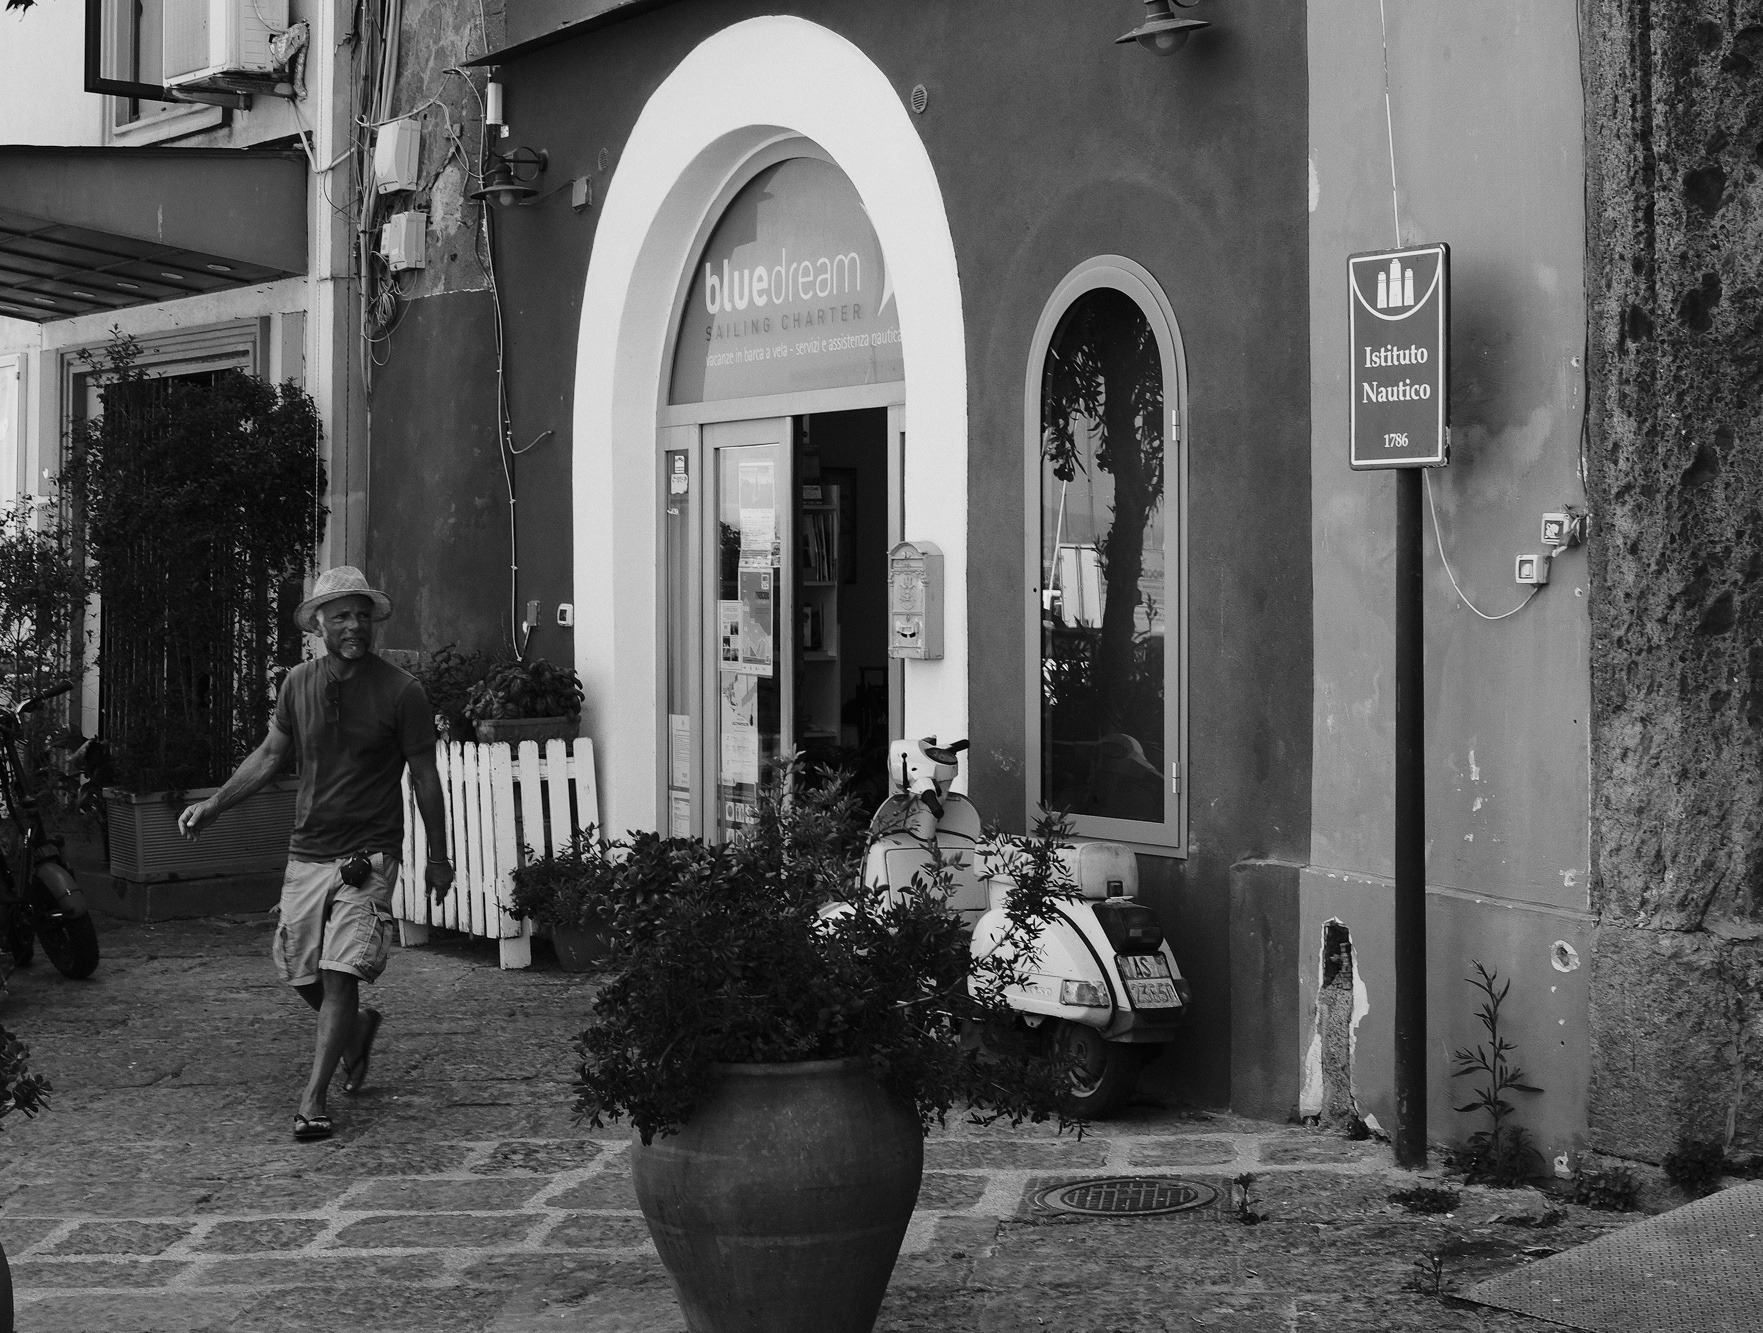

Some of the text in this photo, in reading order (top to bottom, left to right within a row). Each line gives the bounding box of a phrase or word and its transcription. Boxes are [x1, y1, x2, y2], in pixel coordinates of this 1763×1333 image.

[705, 303, 862, 341] SAILING CHARTER
[706, 352, 734, 366] vacanze
[735, 347, 743, 363] in
[744, 346, 764, 362] barca
[765, 347, 771, 359] a
[772, 341, 788, 358] vela
[795, 337, 820, 355] servizi
[821, 339, 827, 352] e
[828, 332, 869, 351] assistenza
[1364, 344, 1428, 368] Istituto
[1362, 378, 1431, 404] Nautico
[1383, 432, 1409, 448] 1786
[1133, 956, 1152, 978] AS
